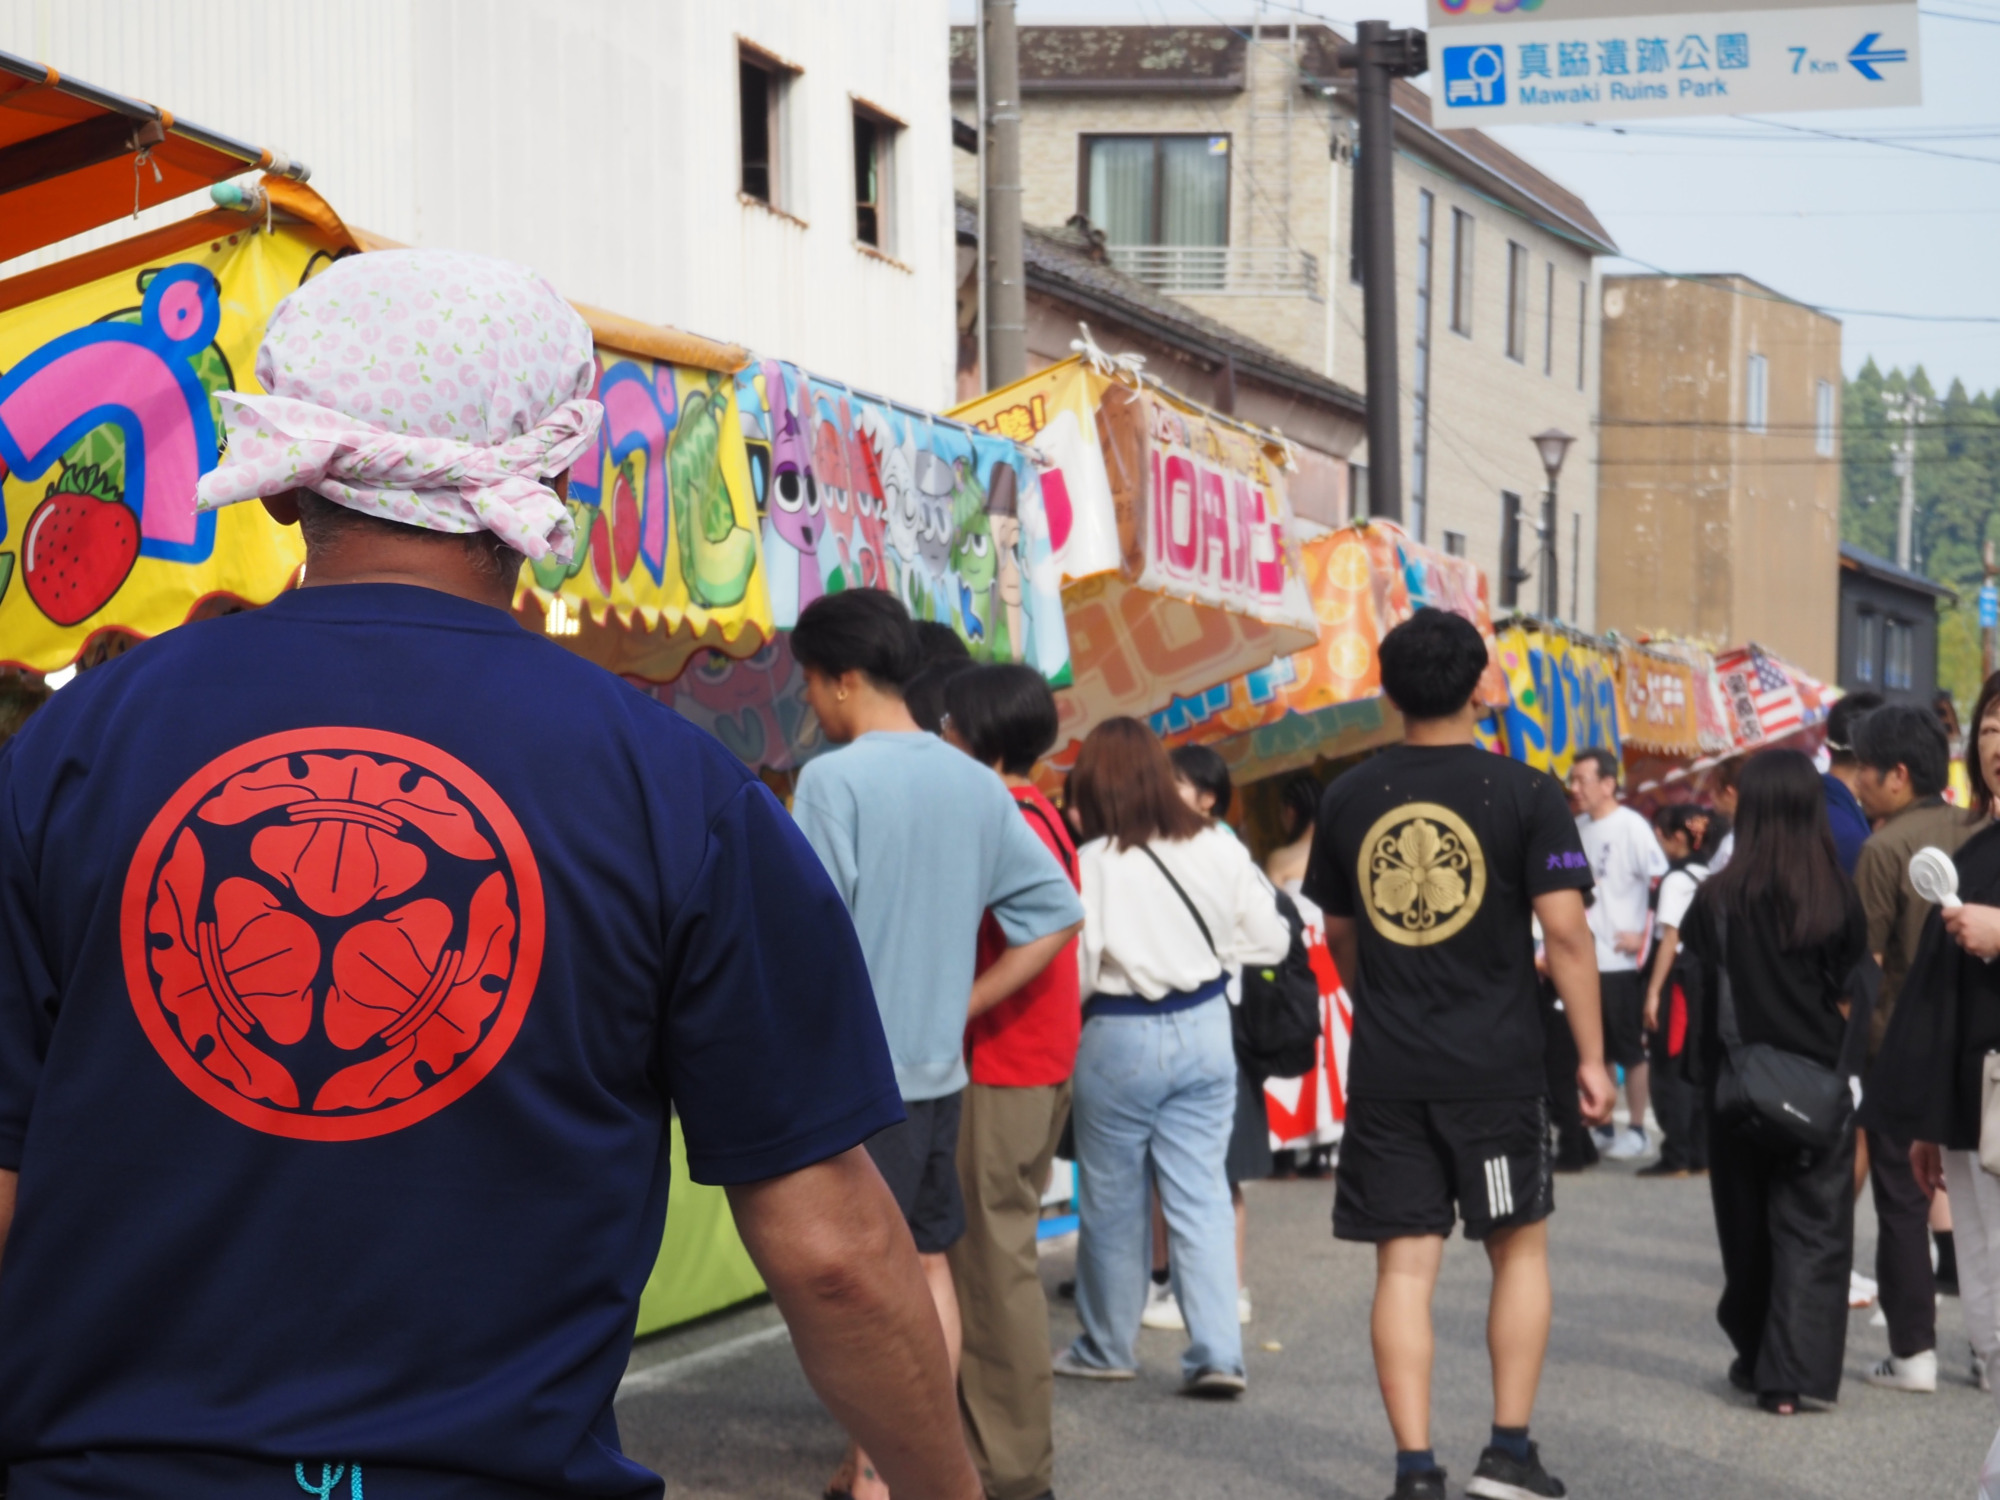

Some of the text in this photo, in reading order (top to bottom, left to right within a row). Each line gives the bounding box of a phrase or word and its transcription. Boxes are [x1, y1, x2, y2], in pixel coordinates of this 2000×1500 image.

[1517, 33, 1748, 79] 真脇遺跡公園
[1519, 77, 1728, 105] Mawaki Ruins Park
